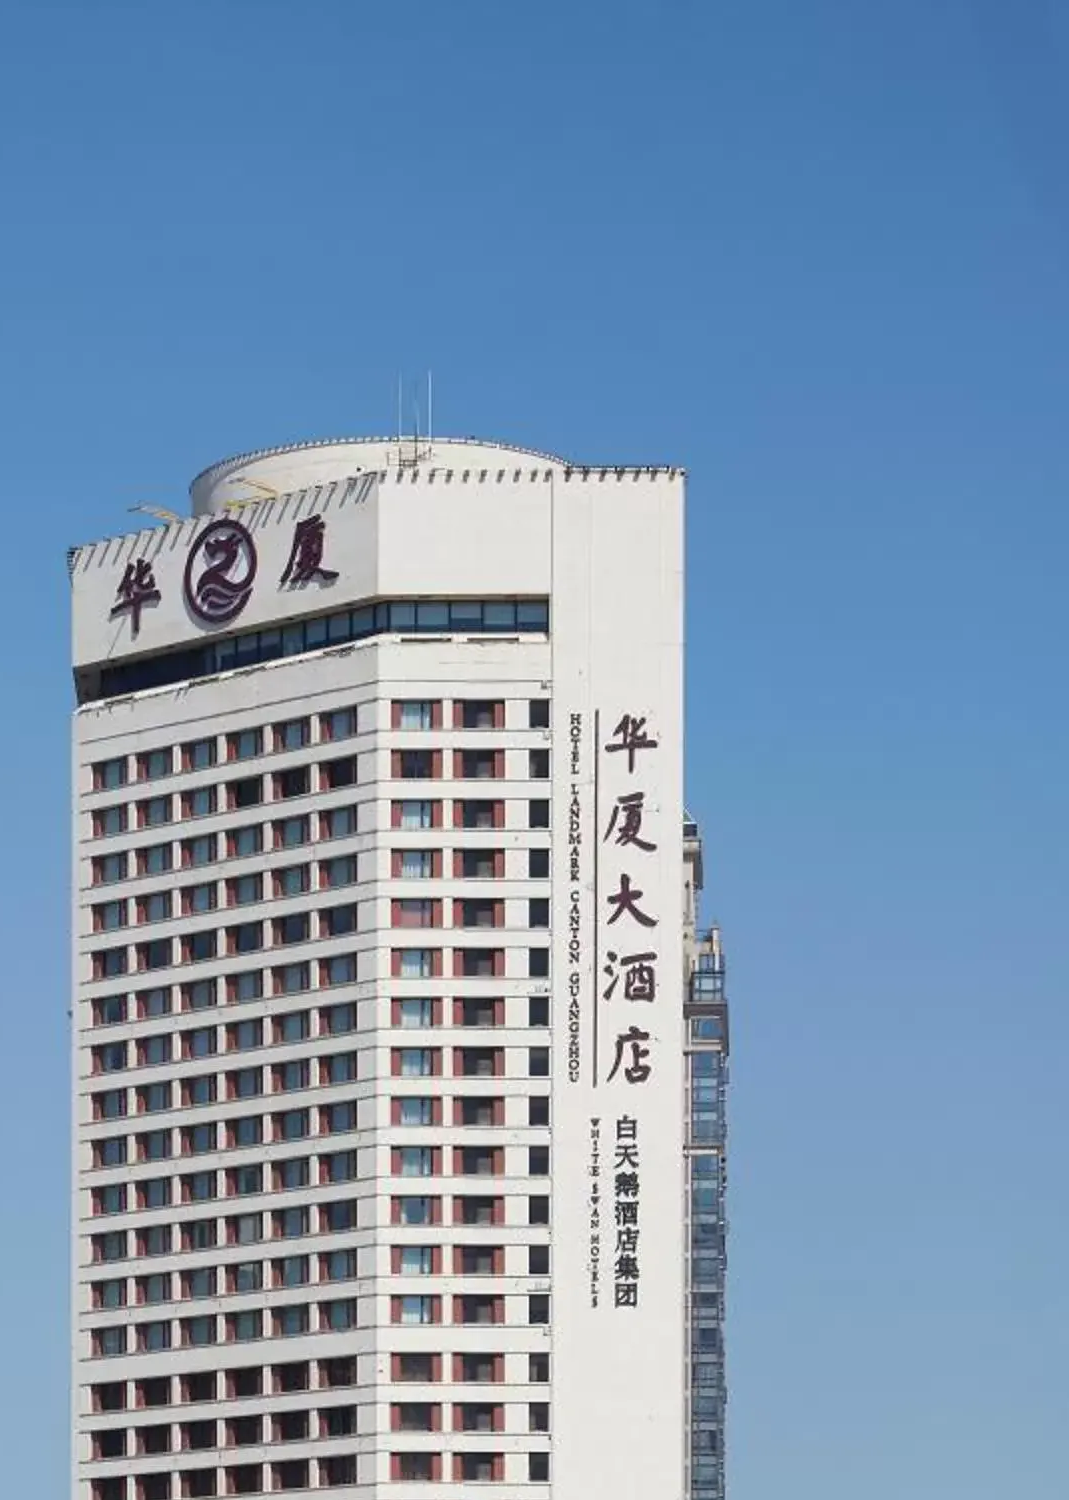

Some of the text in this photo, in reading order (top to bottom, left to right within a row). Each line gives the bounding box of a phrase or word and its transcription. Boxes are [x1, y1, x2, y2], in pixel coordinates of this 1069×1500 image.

[568, 713, 582, 1083] HOTEL LANDMARK CANTON GUANGZHOU
[603, 713, 659, 1084] 华厦大酒店
[590, 1118, 601, 1308] WHITE SWAN HOTELS
[614, 1114, 640, 1308] 白天鹅酒店集团
